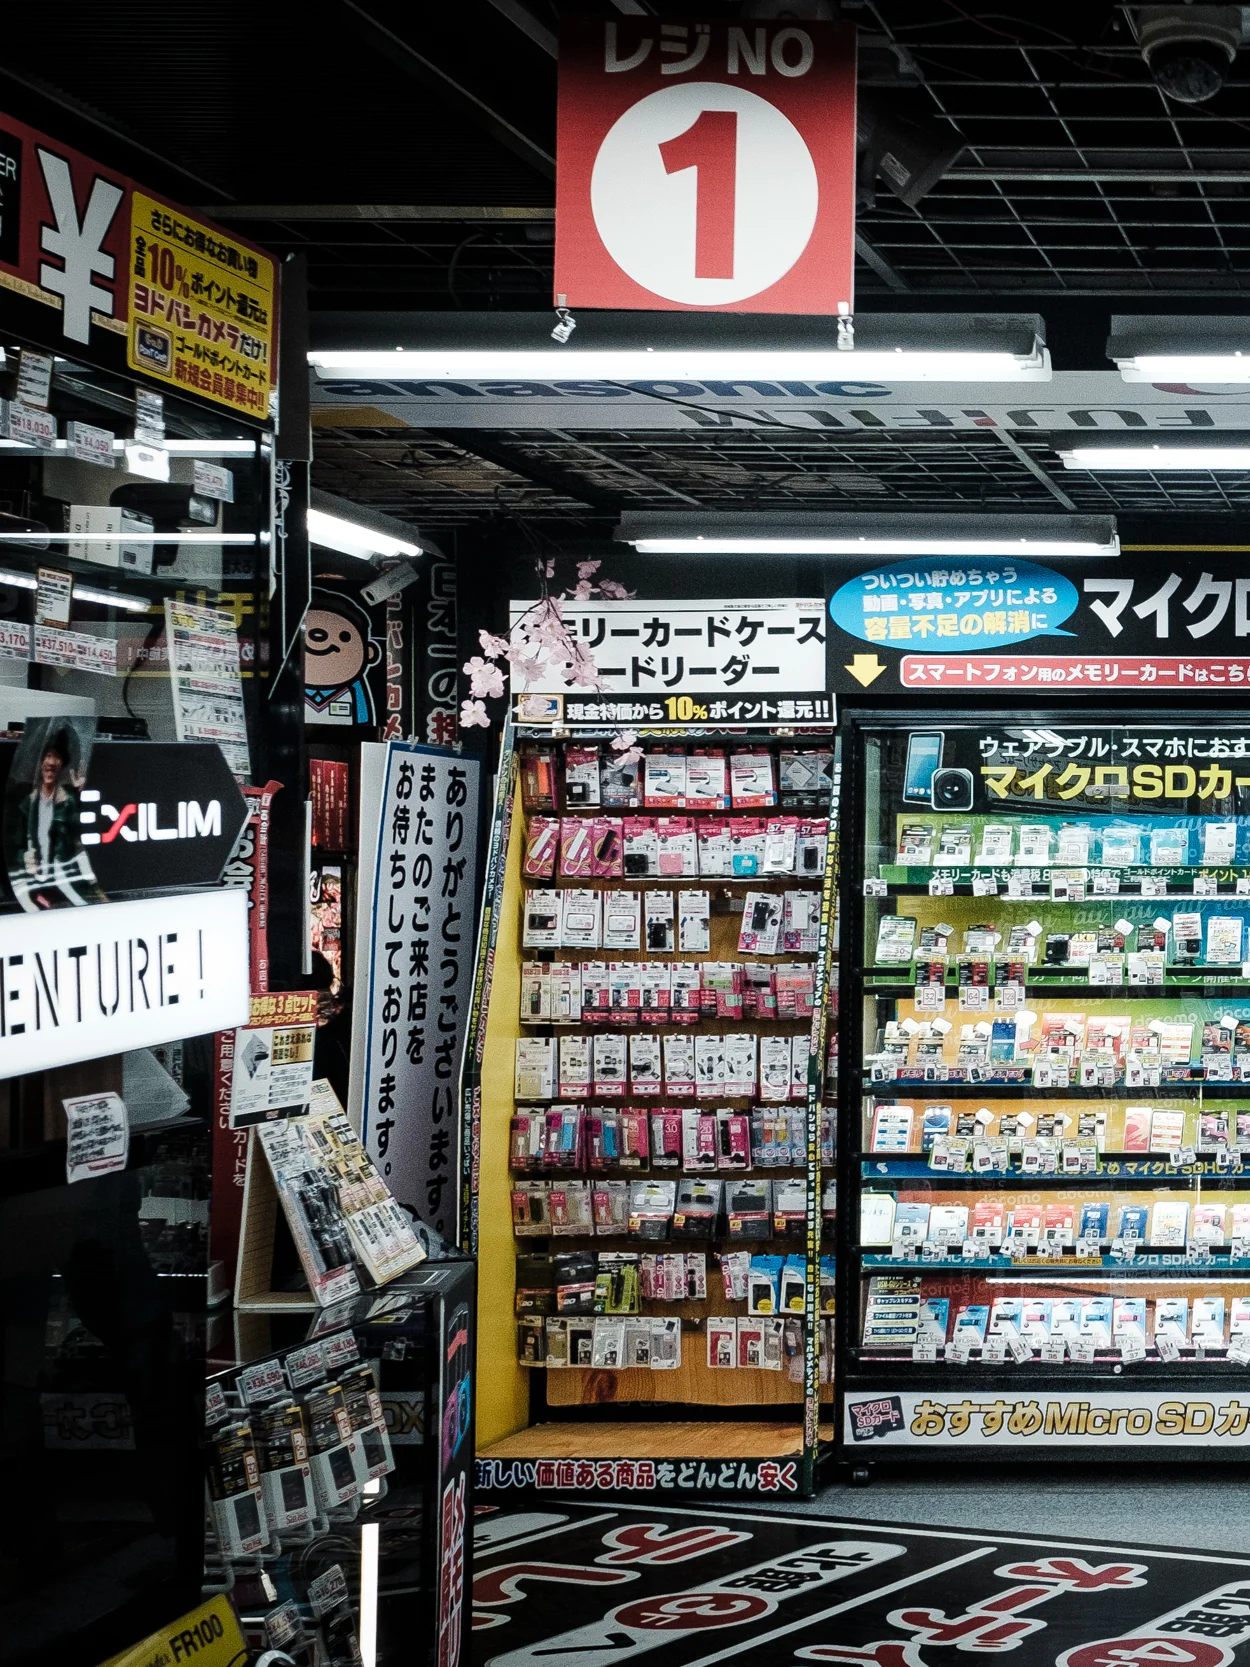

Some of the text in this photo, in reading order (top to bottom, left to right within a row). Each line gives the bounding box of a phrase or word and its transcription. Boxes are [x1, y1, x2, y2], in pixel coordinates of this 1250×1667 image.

[605, 21, 814, 77] レジ NO
[658, 110, 737, 279] 1
[862, 566, 1018, 589] ついつい貯めちゃう
[863, 588, 1058, 612] 動画・写真・アプリによる
[864, 611, 1048, 640] 容量不足の解消に
[564, 654, 780, 688] ードリーダー
[80, 789, 222, 845] EXILIM
[405, 762, 435, 1064] またのご来店を
[851, 1401, 891, 1415] マイクロ
[857, 1411, 900, 1428] SDカード
[169, 1613, 224, 1664] FR100
